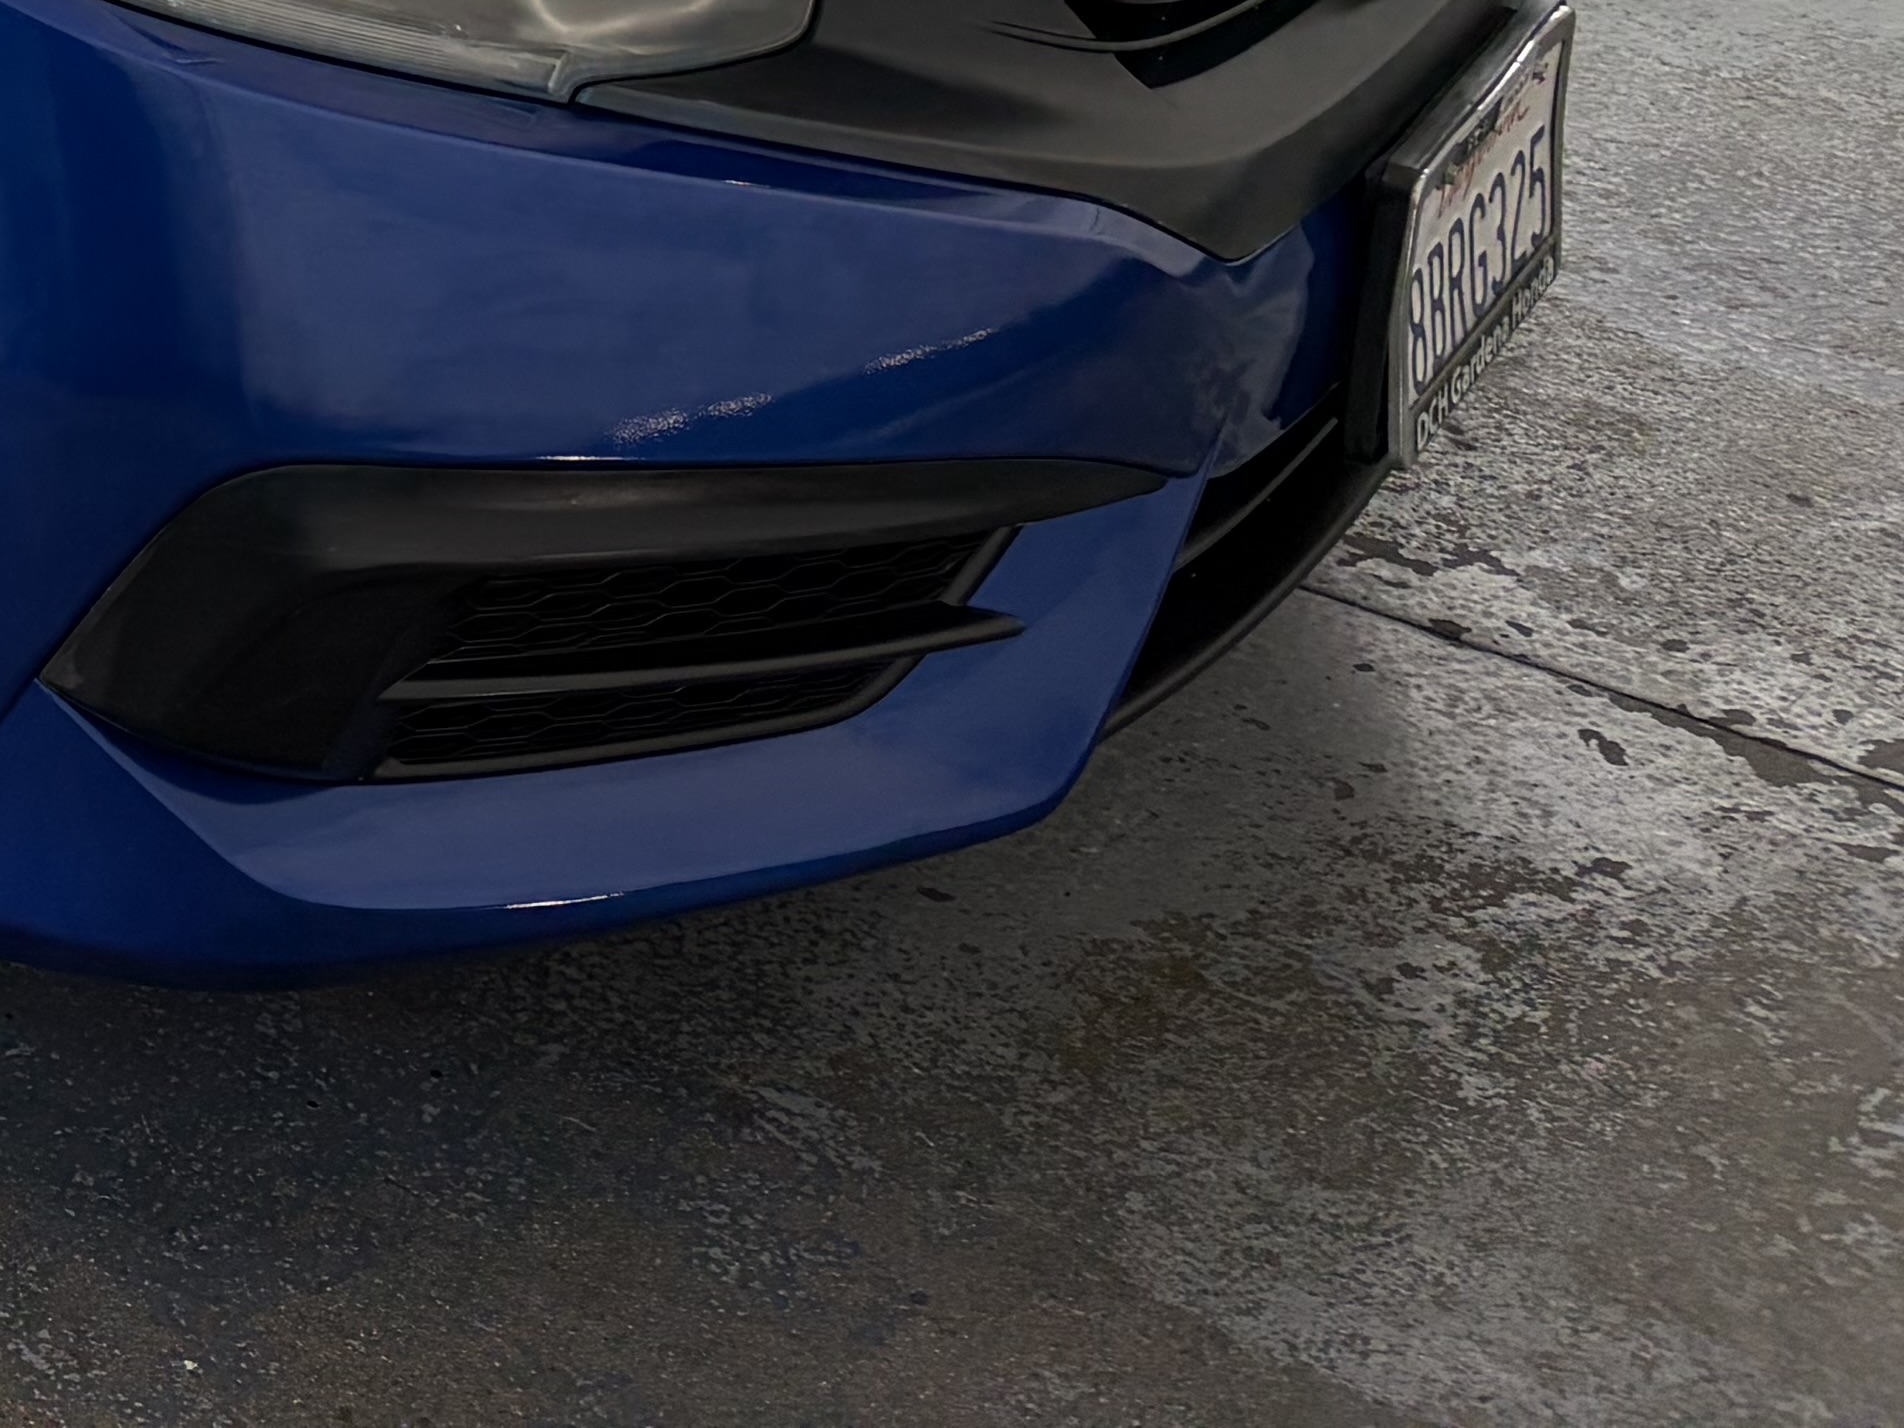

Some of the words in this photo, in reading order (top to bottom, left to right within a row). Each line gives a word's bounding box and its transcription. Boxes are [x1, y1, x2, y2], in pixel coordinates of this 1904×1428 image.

[1410, 123, 1546, 394] 8BRG325
[1415, 382, 1449, 451] DCH
[1449, 314, 1510, 405] Gardena
[1511, 255, 1555, 330] Honda
